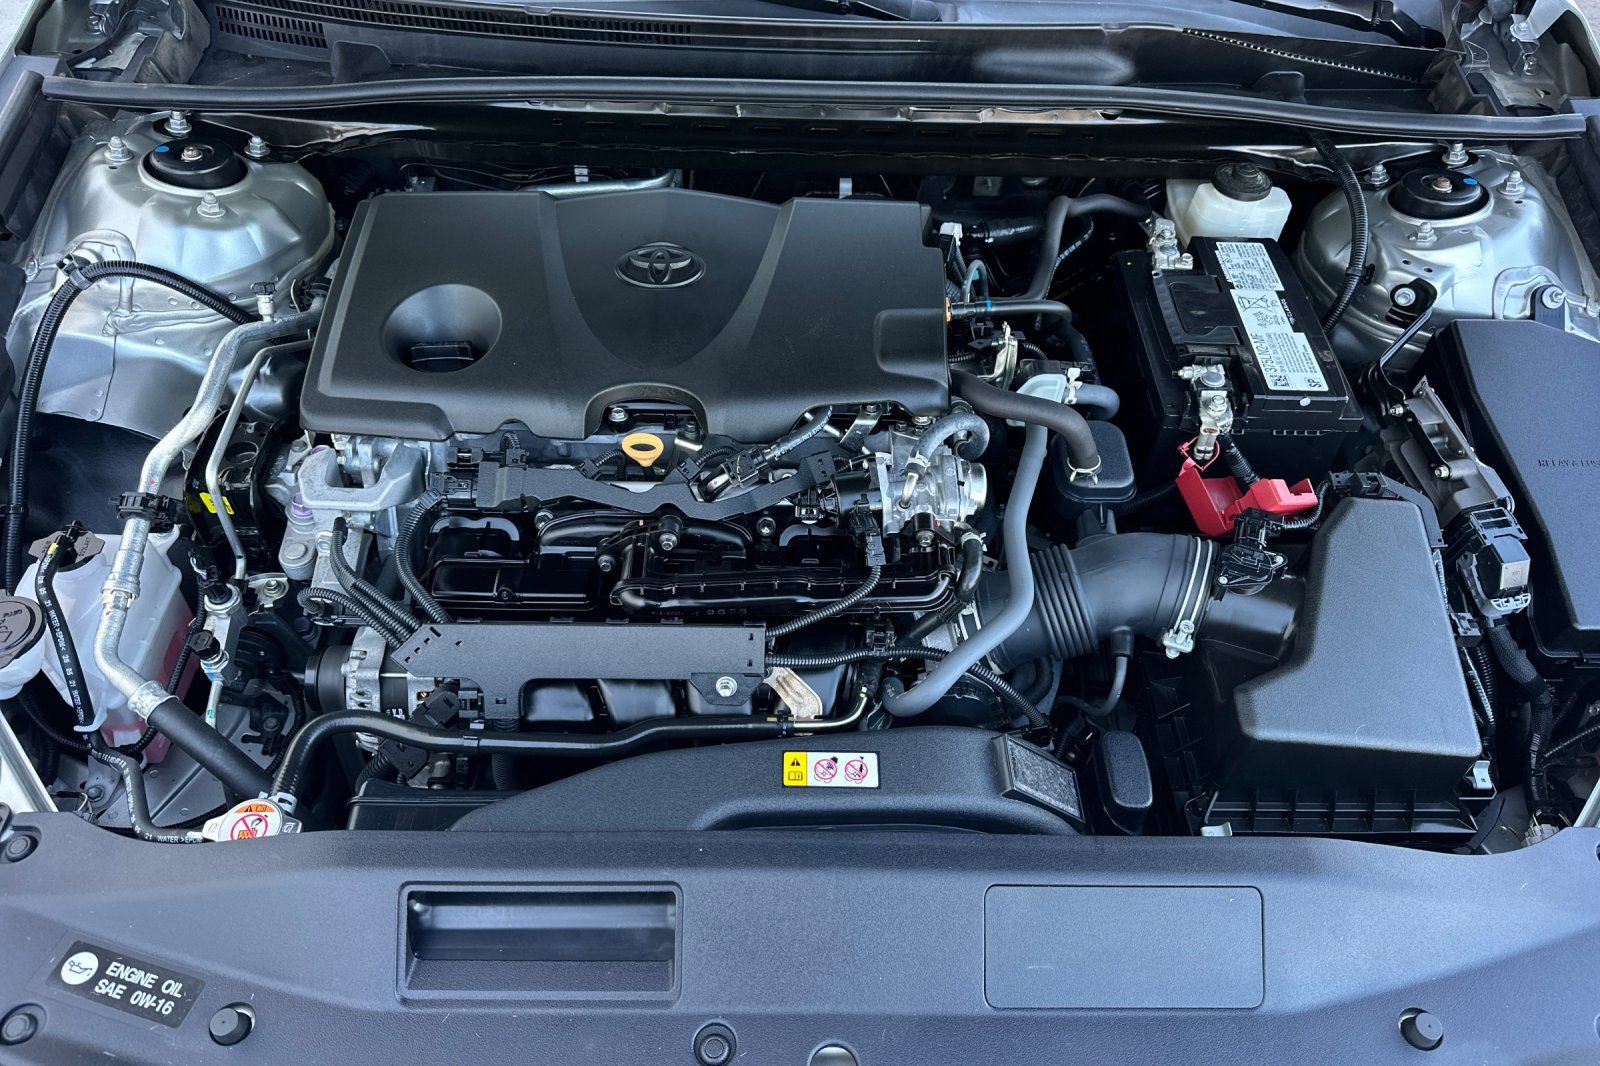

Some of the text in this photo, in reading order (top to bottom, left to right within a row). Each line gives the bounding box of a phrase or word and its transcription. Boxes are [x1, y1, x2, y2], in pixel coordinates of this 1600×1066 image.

[1307, 378, 1322, 388] SP
[48, 609, 60, 628] WATER
[157, 835, 179, 843] WATER
[105, 961, 183, 998] ENGINE OIL
[94, 978, 175, 1015] SAE 0W-16
